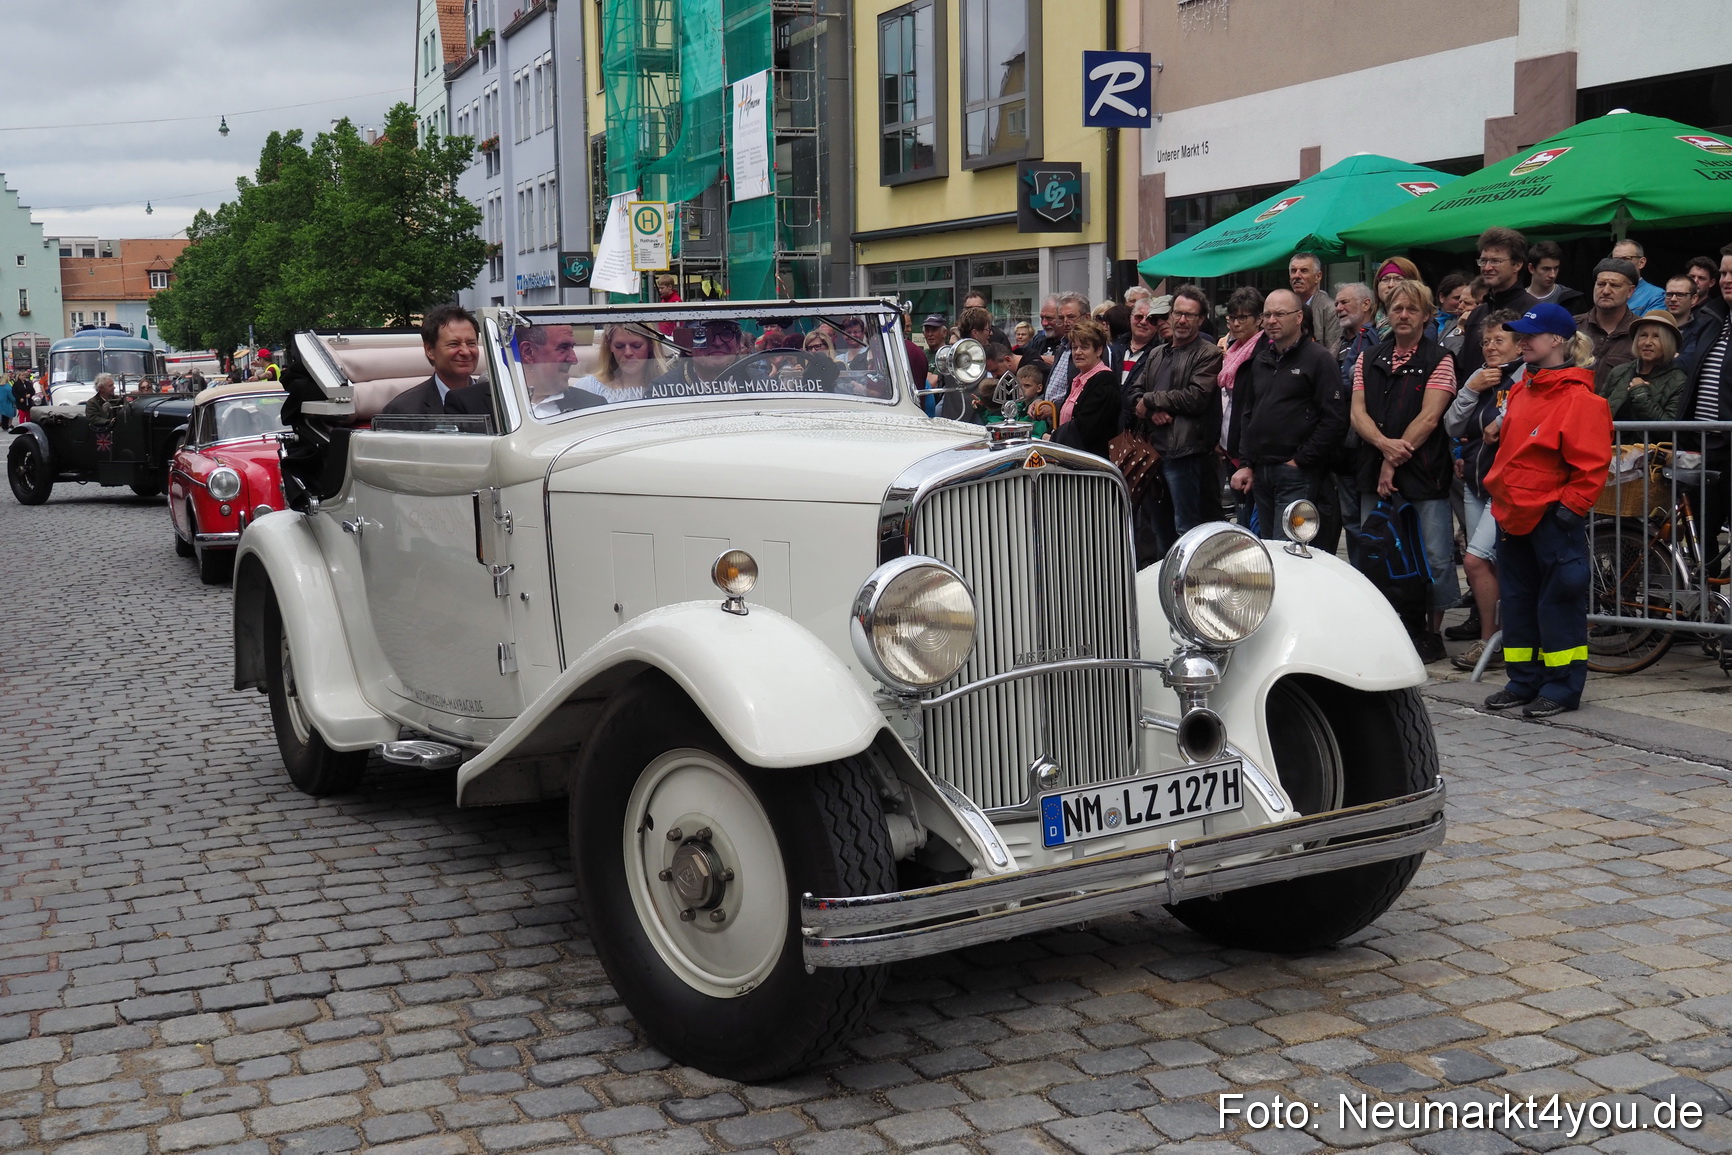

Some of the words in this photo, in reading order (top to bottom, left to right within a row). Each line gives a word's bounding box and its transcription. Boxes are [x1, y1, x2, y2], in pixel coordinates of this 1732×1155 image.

[1157, 150, 1180, 163] Unterer
[1181, 144, 1200, 158] Markt
[1202, 141, 1210, 155] 15
[1044, 181, 1066, 209] G2
[1463, 175, 1553, 195] Neumarkter
[1427, 184, 1552, 212] Lammsbräu
[571, 261, 583, 276] G2
[1062, 794, 1103, 837] NM
[1123, 783, 1161, 825] LZ
[1050, 826, 1057, 837] D
